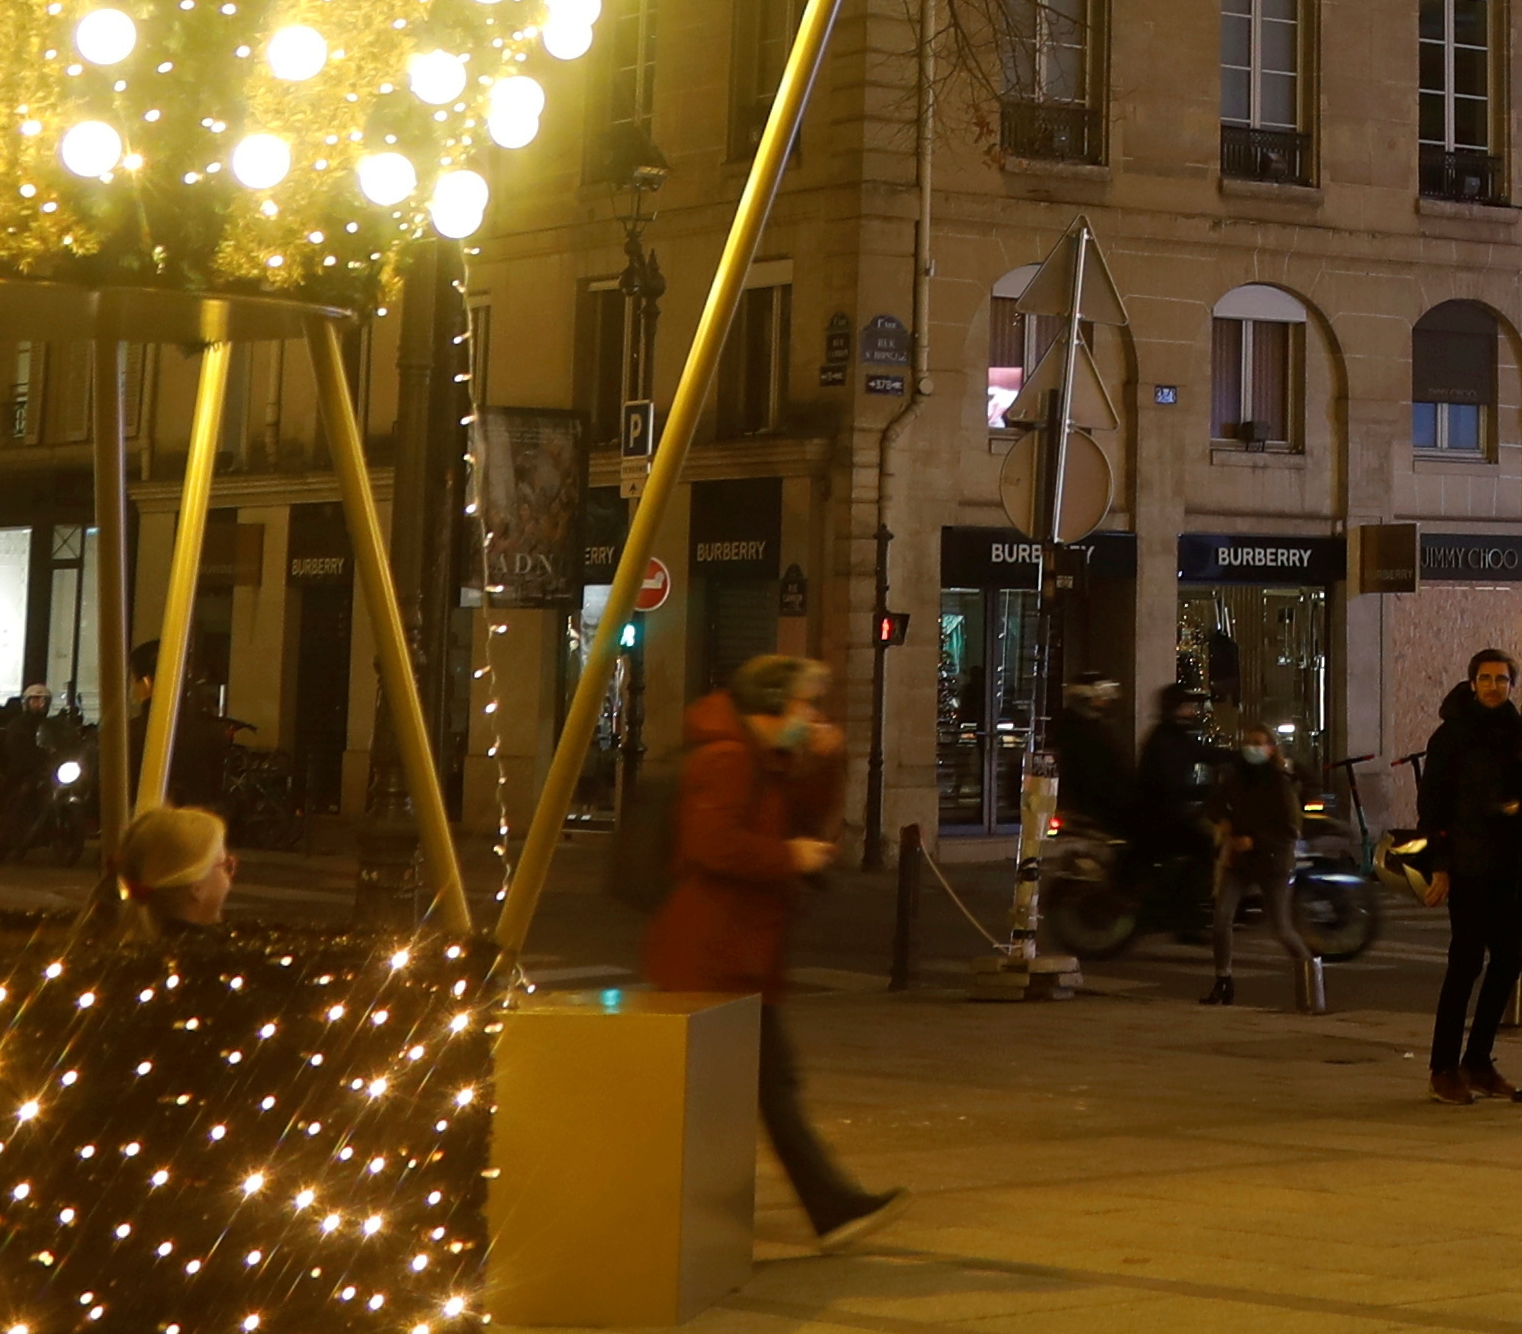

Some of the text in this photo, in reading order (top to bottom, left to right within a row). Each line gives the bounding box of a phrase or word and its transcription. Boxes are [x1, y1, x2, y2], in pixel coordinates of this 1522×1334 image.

[629, 413, 642, 448] P
[585, 547, 615, 564] ERRY
[697, 541, 766, 562] BURBERRY
[991, 543, 1095, 564] BURBY
[1218, 547, 1312, 567] BURBERRY
[1421, 547, 1518, 569] JIMMY CHOO
[292, 557, 345, 576] BURBERRY
